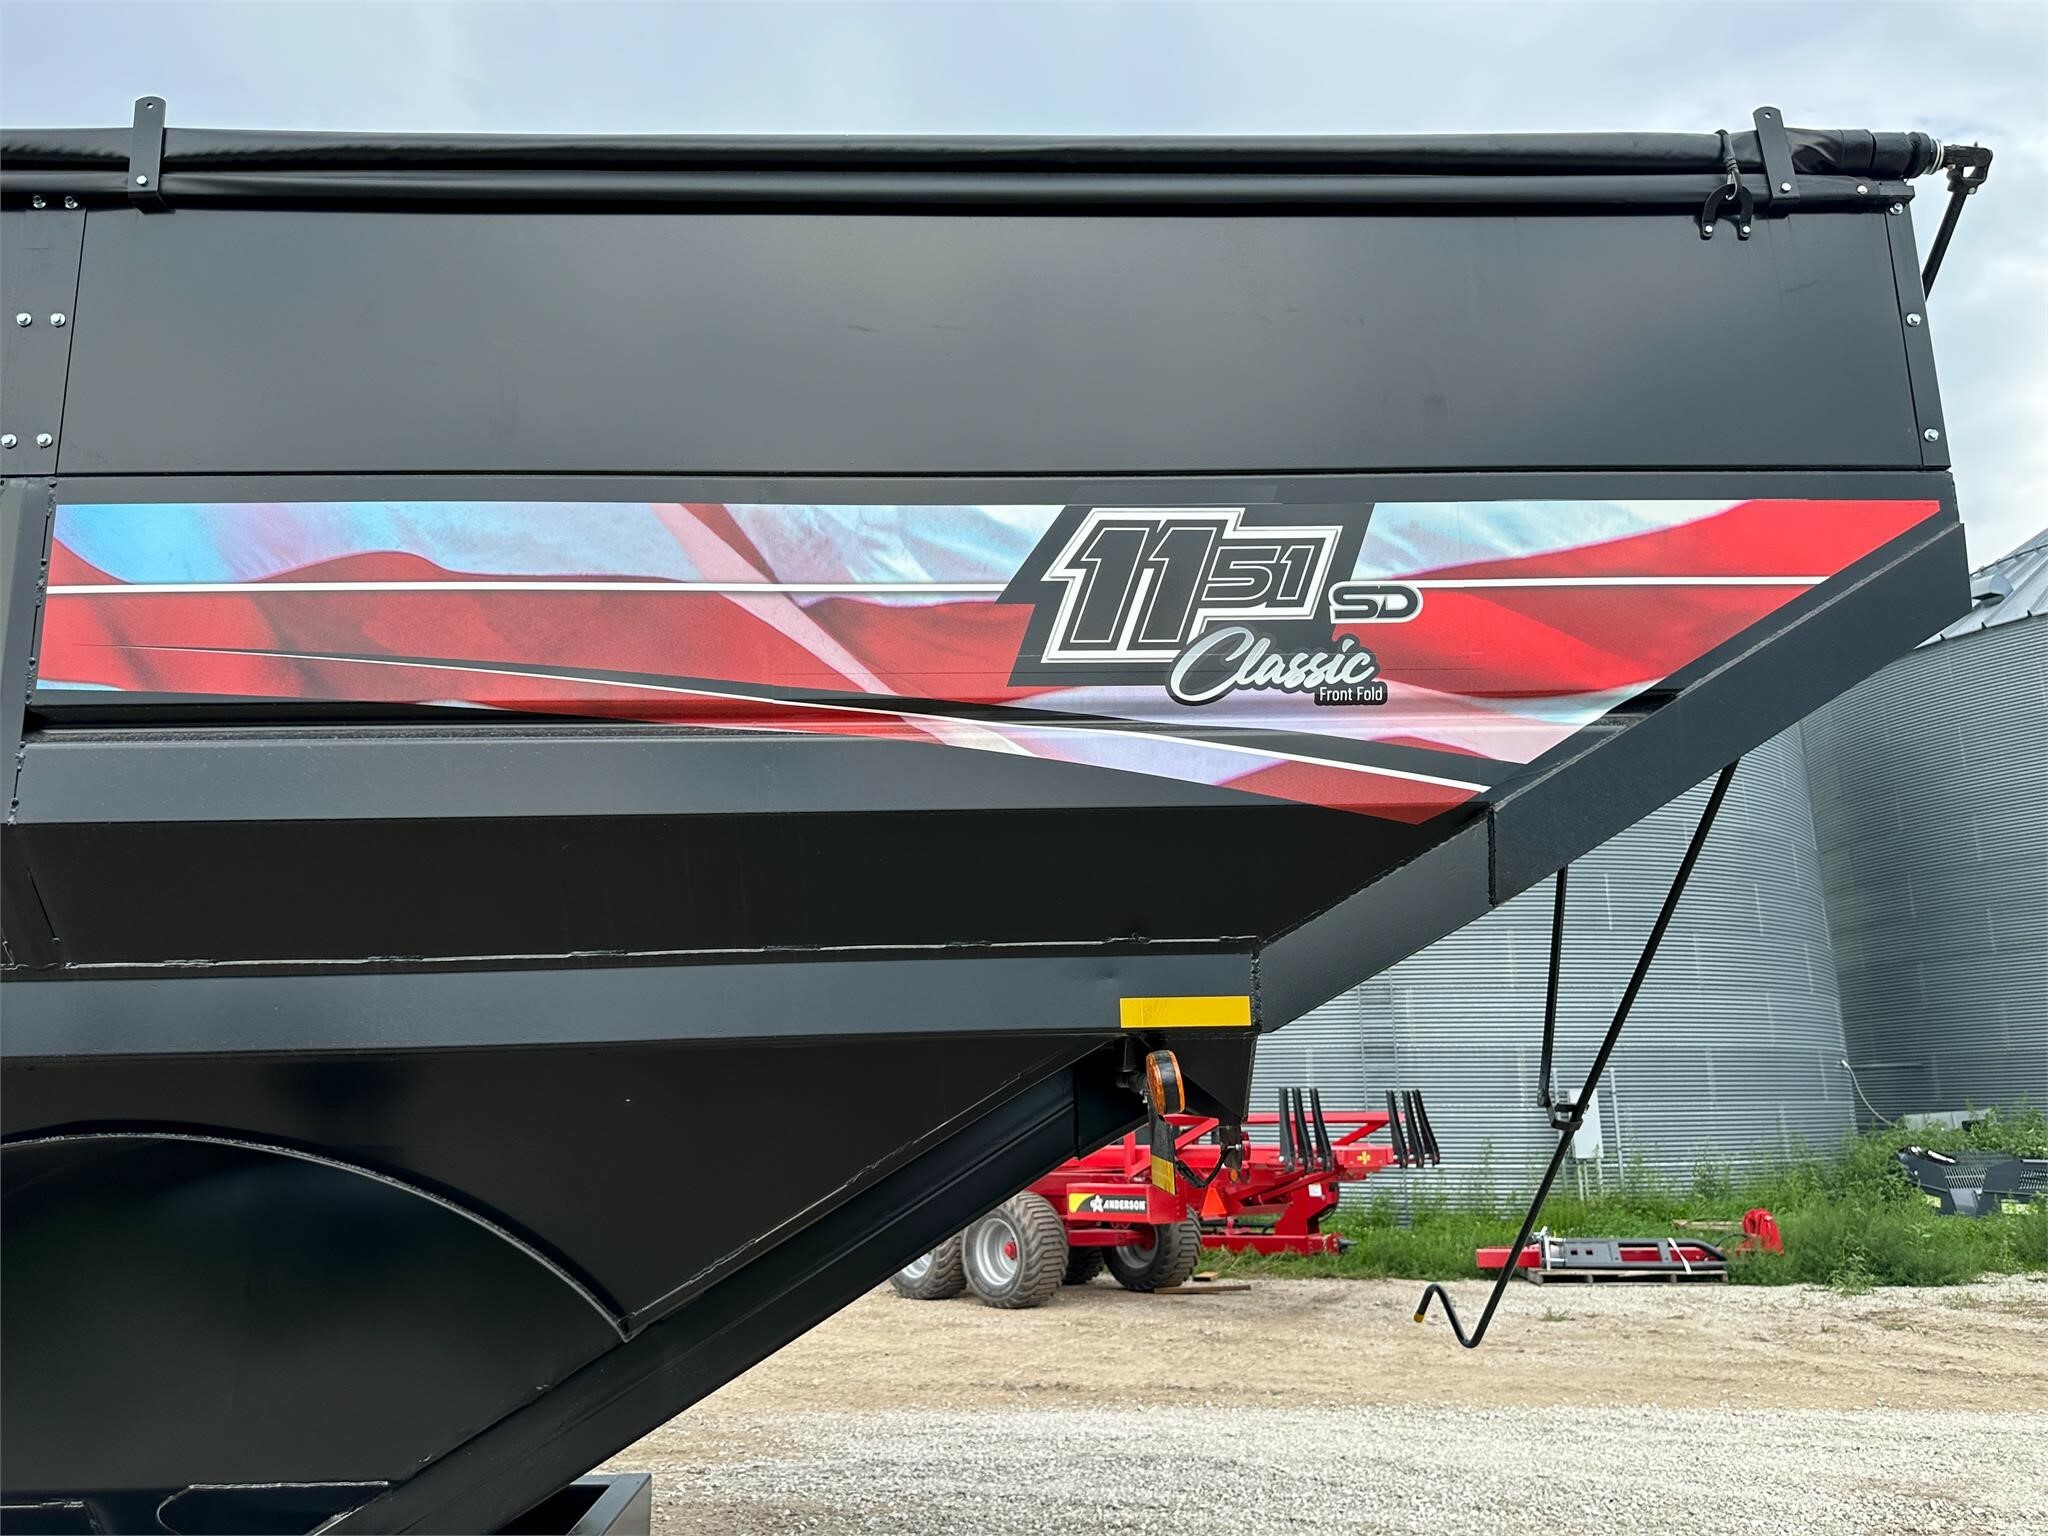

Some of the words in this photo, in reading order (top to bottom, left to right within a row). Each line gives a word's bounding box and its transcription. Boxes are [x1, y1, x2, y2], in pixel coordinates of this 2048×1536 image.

[1330, 583, 1421, 621] SD
[1170, 626, 1376, 701] Classic
[1319, 686, 1353, 702] Front
[1356, 686, 1383, 702] Fold
[1103, 1199, 1146, 1210] ANDERSON
